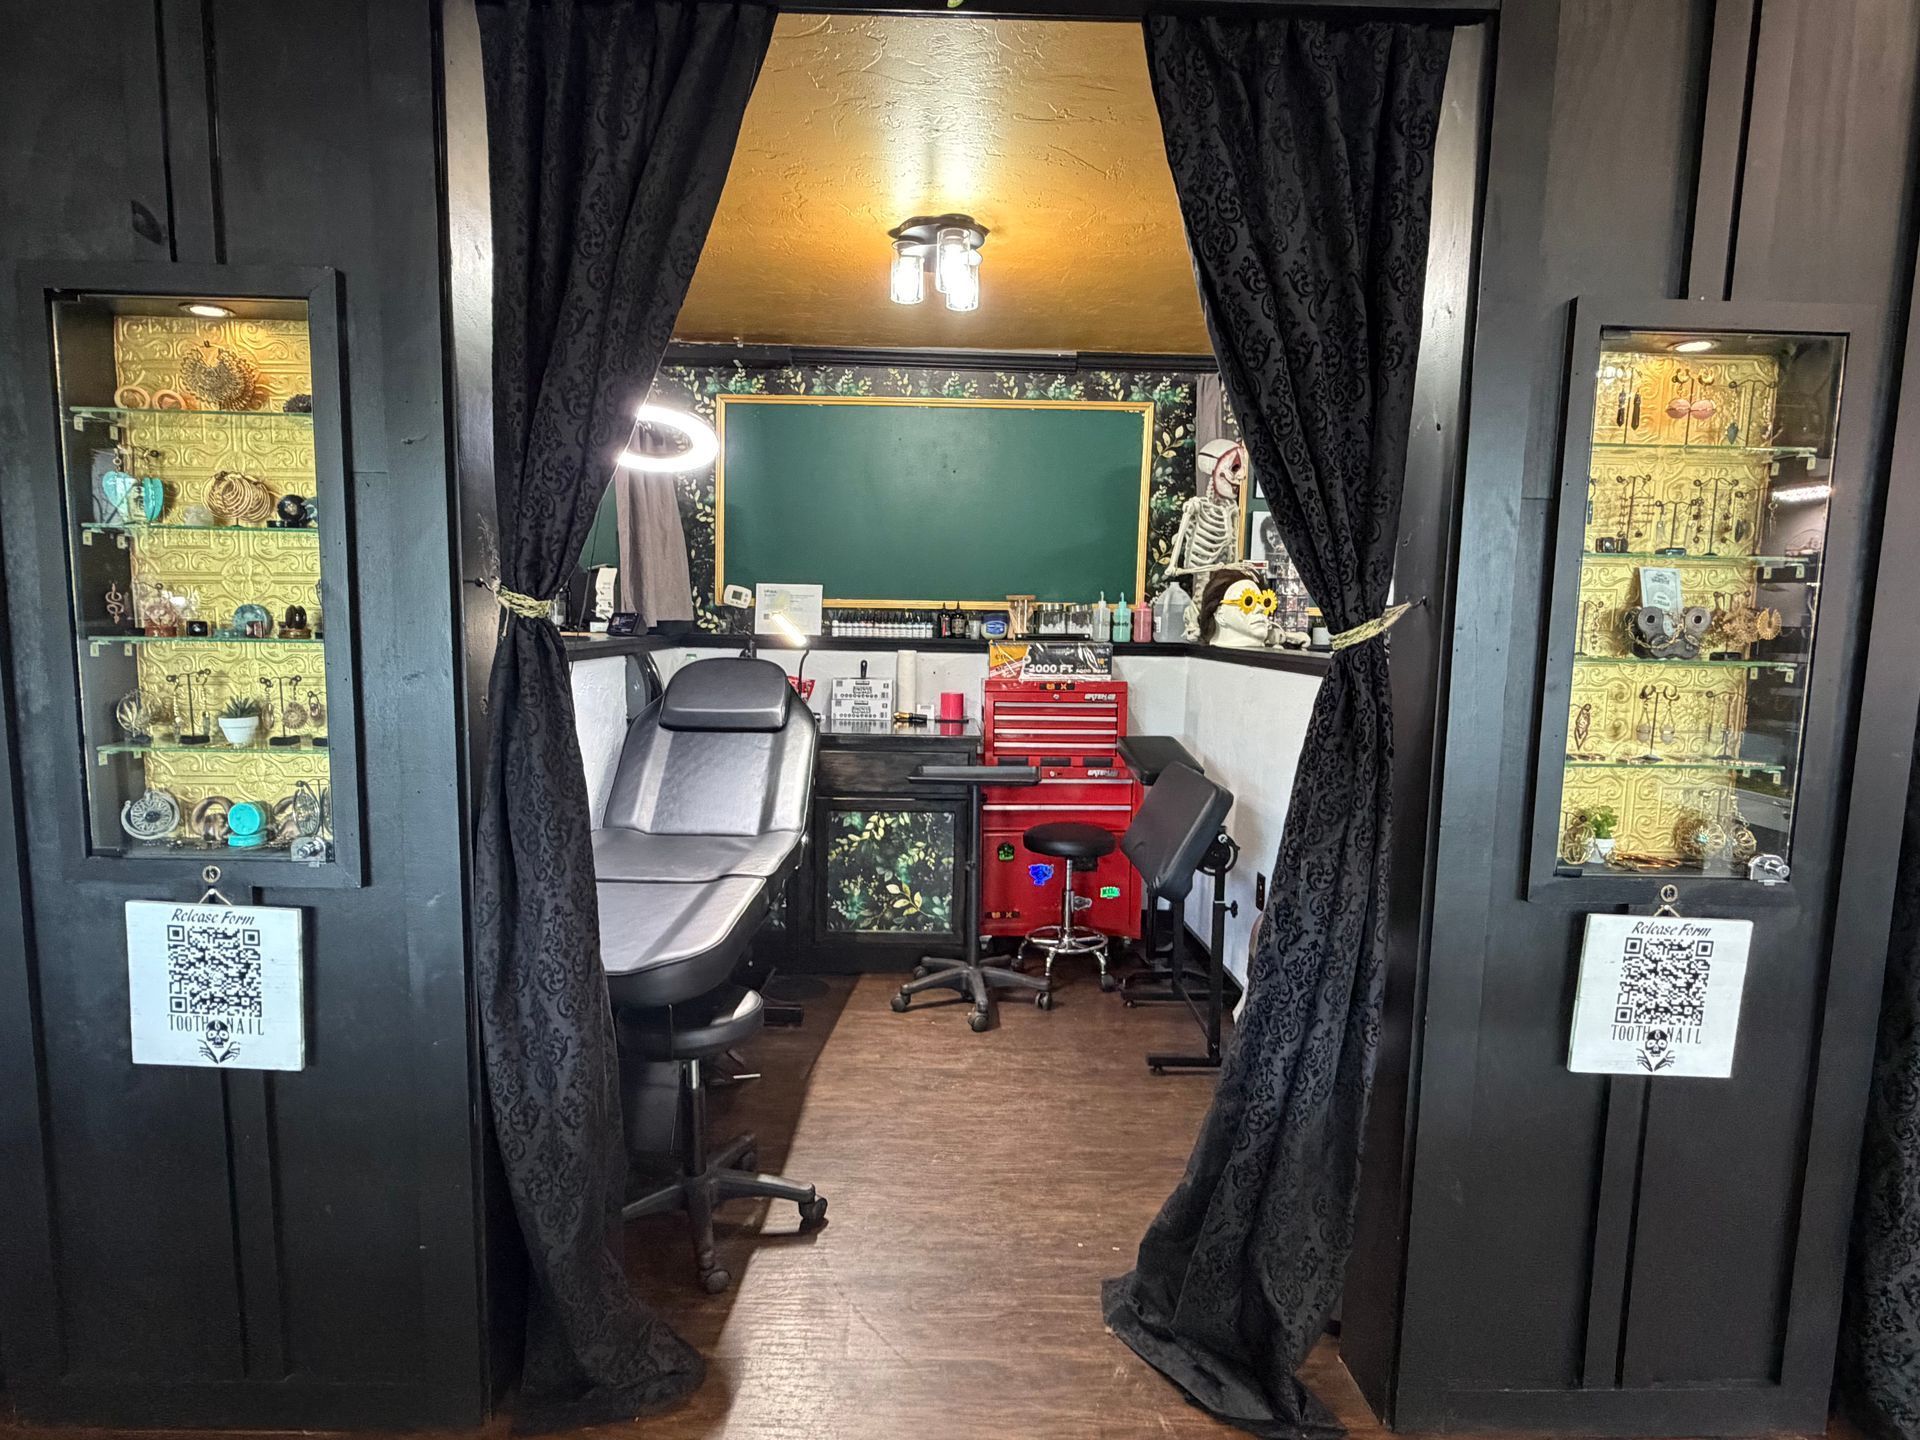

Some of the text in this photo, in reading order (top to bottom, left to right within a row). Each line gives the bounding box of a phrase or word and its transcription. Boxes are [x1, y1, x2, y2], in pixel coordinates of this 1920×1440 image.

[1029, 664, 1057, 673] 2000
[171, 907, 255, 925] Release Form
[1631, 921, 1711, 937] Release Form
[167, 1013, 264, 1035] TOOTH NAIL
[1611, 1024, 1701, 1044] TOOTH NAIL
